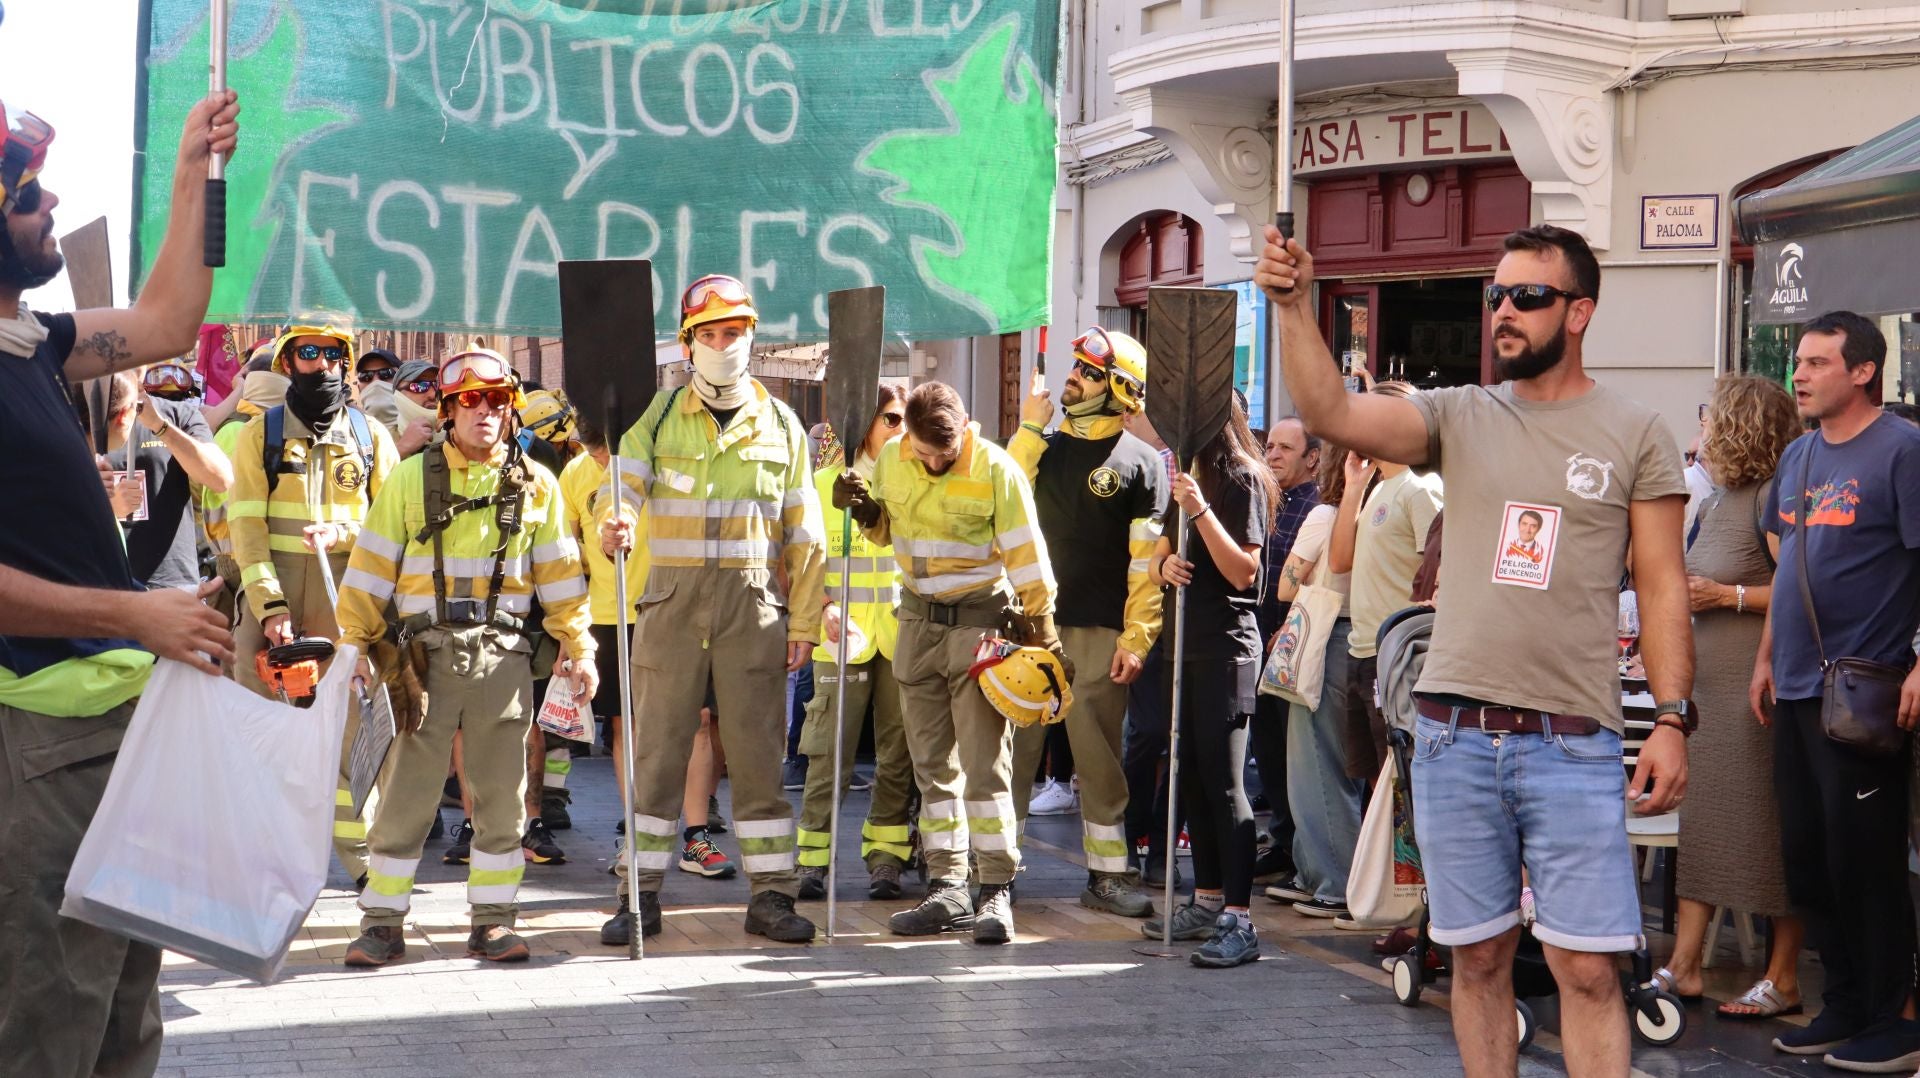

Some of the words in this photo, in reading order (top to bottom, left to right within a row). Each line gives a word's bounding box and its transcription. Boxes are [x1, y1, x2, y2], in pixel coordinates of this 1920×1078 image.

[381, 3, 800, 144] PÚBLICOS
[559, 130, 618, 200] Y
[1665, 205, 1695, 217] CALLE
[1656, 223, 1704, 238] PALOMA
[1788, 280, 1795, 288] EL
[1769, 287, 1808, 304] ÁGUILA
[1502, 560, 1540, 570] PELIGRO
[1498, 567, 1508, 575] DE
[1508, 568, 1542, 580] INCENDIO
